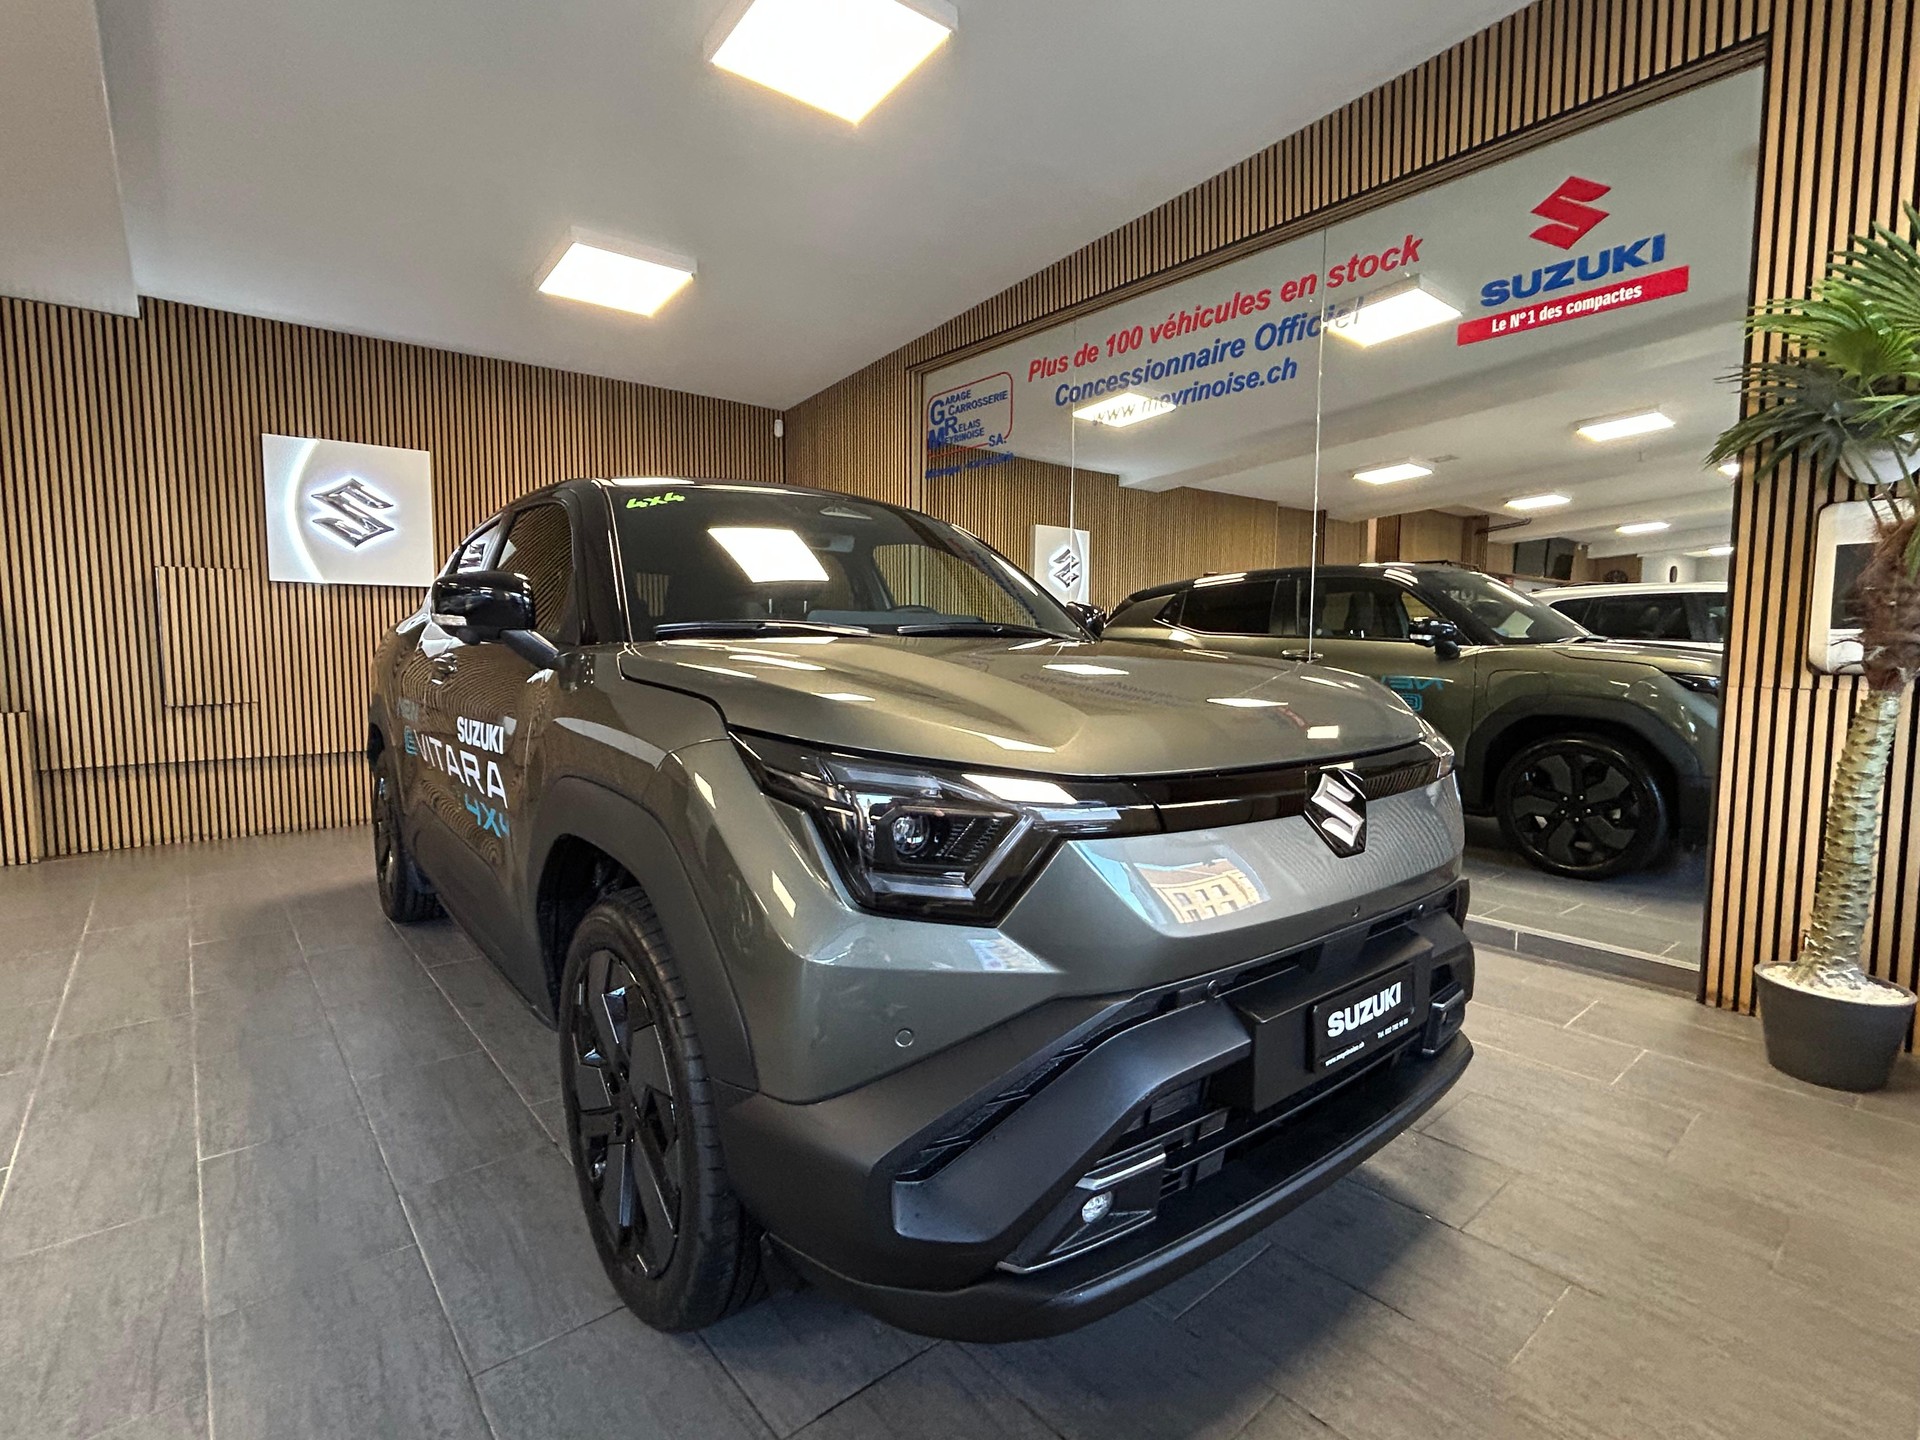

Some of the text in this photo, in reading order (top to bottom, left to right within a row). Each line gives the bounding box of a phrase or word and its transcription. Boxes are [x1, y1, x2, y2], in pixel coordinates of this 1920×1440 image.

[1480, 234, 1666, 307] SUZUKI
[1028, 234, 1423, 382] Plus de 100 véhicules en stock
[1491, 318, 1507, 333] Le
[1539, 305, 1563, 321] des
[1566, 284, 1643, 315] compactes
[1055, 296, 1364, 406] Concessionnaire Officiel
[930, 389, 972, 426] GARAGE
[943, 416, 981, 436] RELAIS
[948, 390, 1008, 416] CARROSSERIE
[457, 716, 505, 755] SUZUKI
[1327, 981, 1402, 1038] SUZUKI
